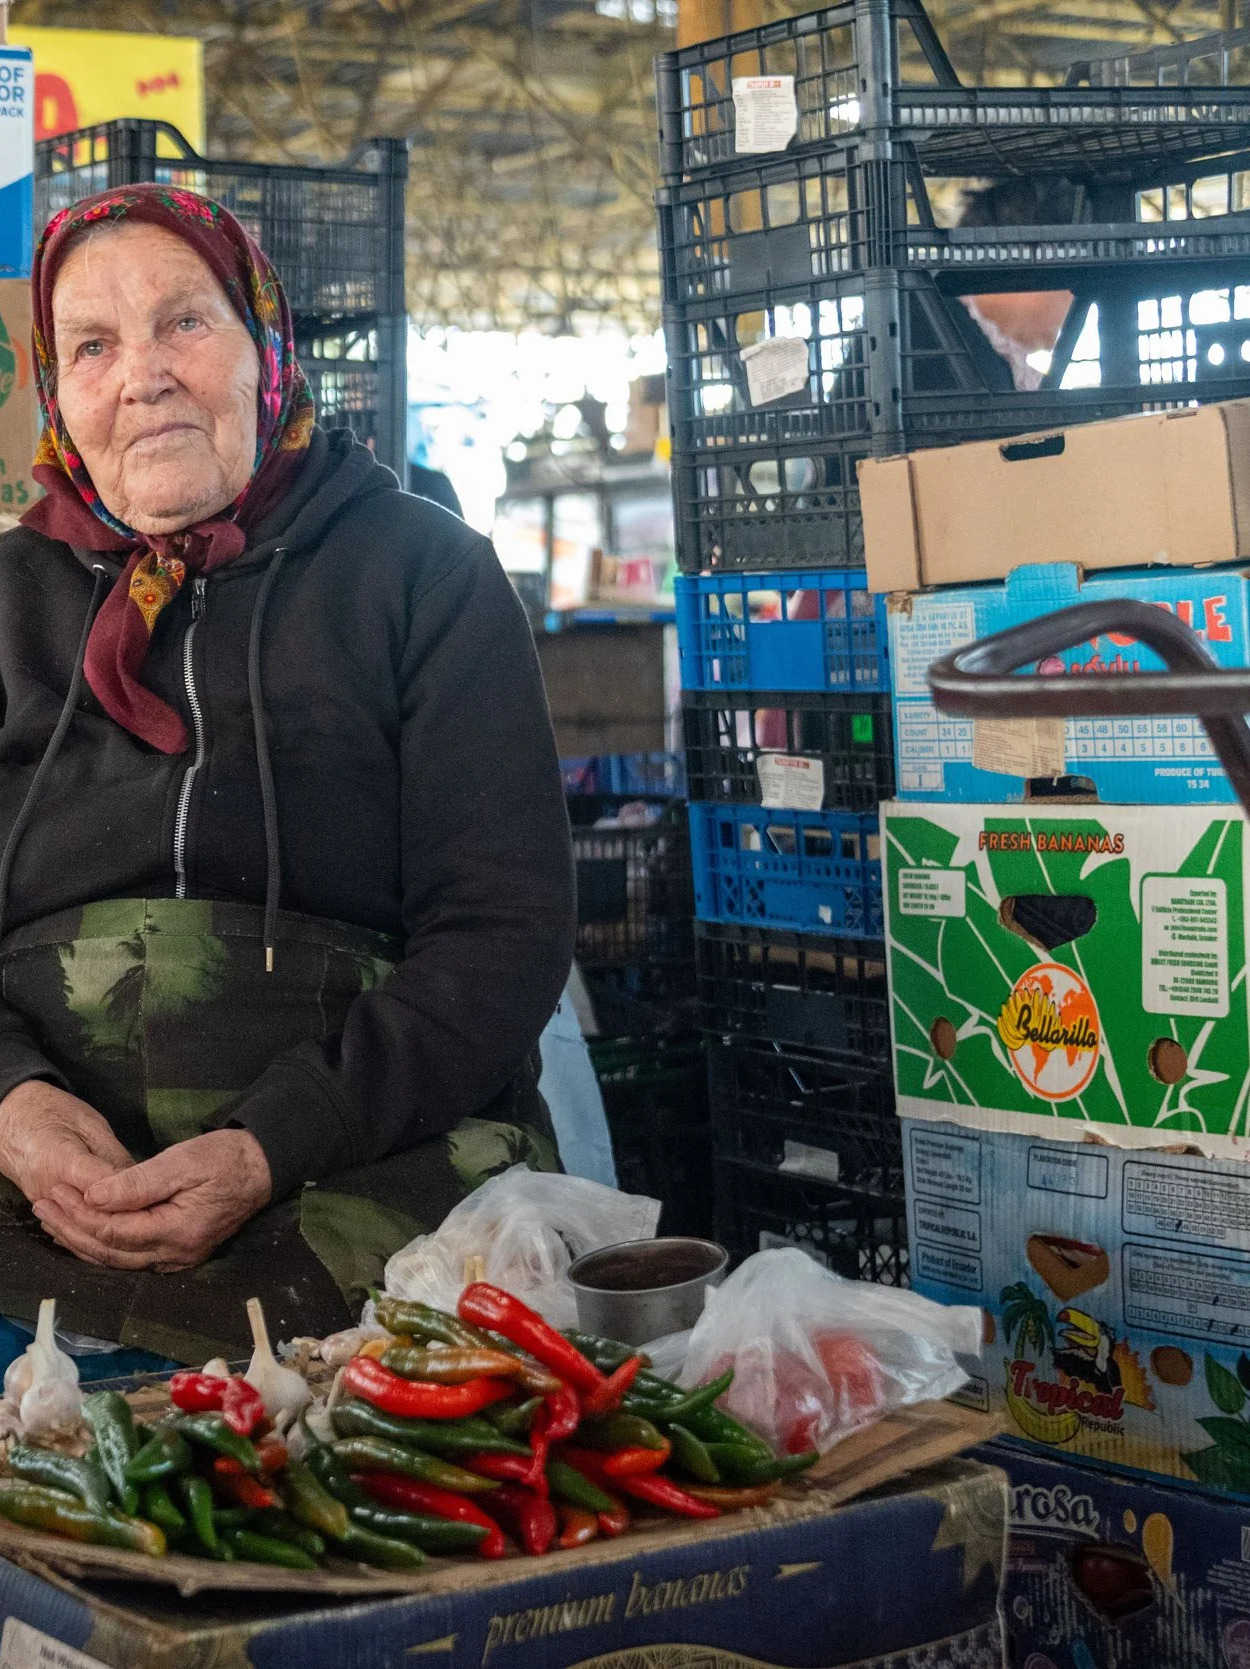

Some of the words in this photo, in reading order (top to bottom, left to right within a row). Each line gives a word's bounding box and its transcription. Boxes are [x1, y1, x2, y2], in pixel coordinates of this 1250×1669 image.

[904, 728, 927, 736] COUNT
[941, 728, 951, 736] 24
[1118, 724, 1129, 734] 50
[1137, 724, 1148, 734] 55
[1176, 723, 1187, 733] 60
[1082, 743, 1088, 753] 3
[1101, 744, 1107, 752] 4
[1121, 744, 1126, 752] 4
[1140, 743, 1146, 751] 5
[1160, 743, 1166, 751] 5
[1180, 742, 1186, 751] 6
[1154, 768, 1192, 777] PRODUCE
[1193, 768, 1205, 776] OF
[1206, 768, 1227, 776] TUR
[1187, 780, 1197, 788] TS
[1198, 780, 1210, 788] 34
[979, 832, 1032, 850] FRESH
[1036, 832, 1125, 854] BANANAS
[1016, 1003, 1097, 1049] Bellarillo
[922, 1252, 944, 1266] Product
[952, 1259, 977, 1273] Ecuador
[1008, 1361, 1126, 1421] Tropical
[1081, 1418, 1125, 1437] Republic
[1008, 1486, 1094, 1528] rosa
[481, 1592, 615, 1667] premium
[624, 1564, 750, 1618] bananas
